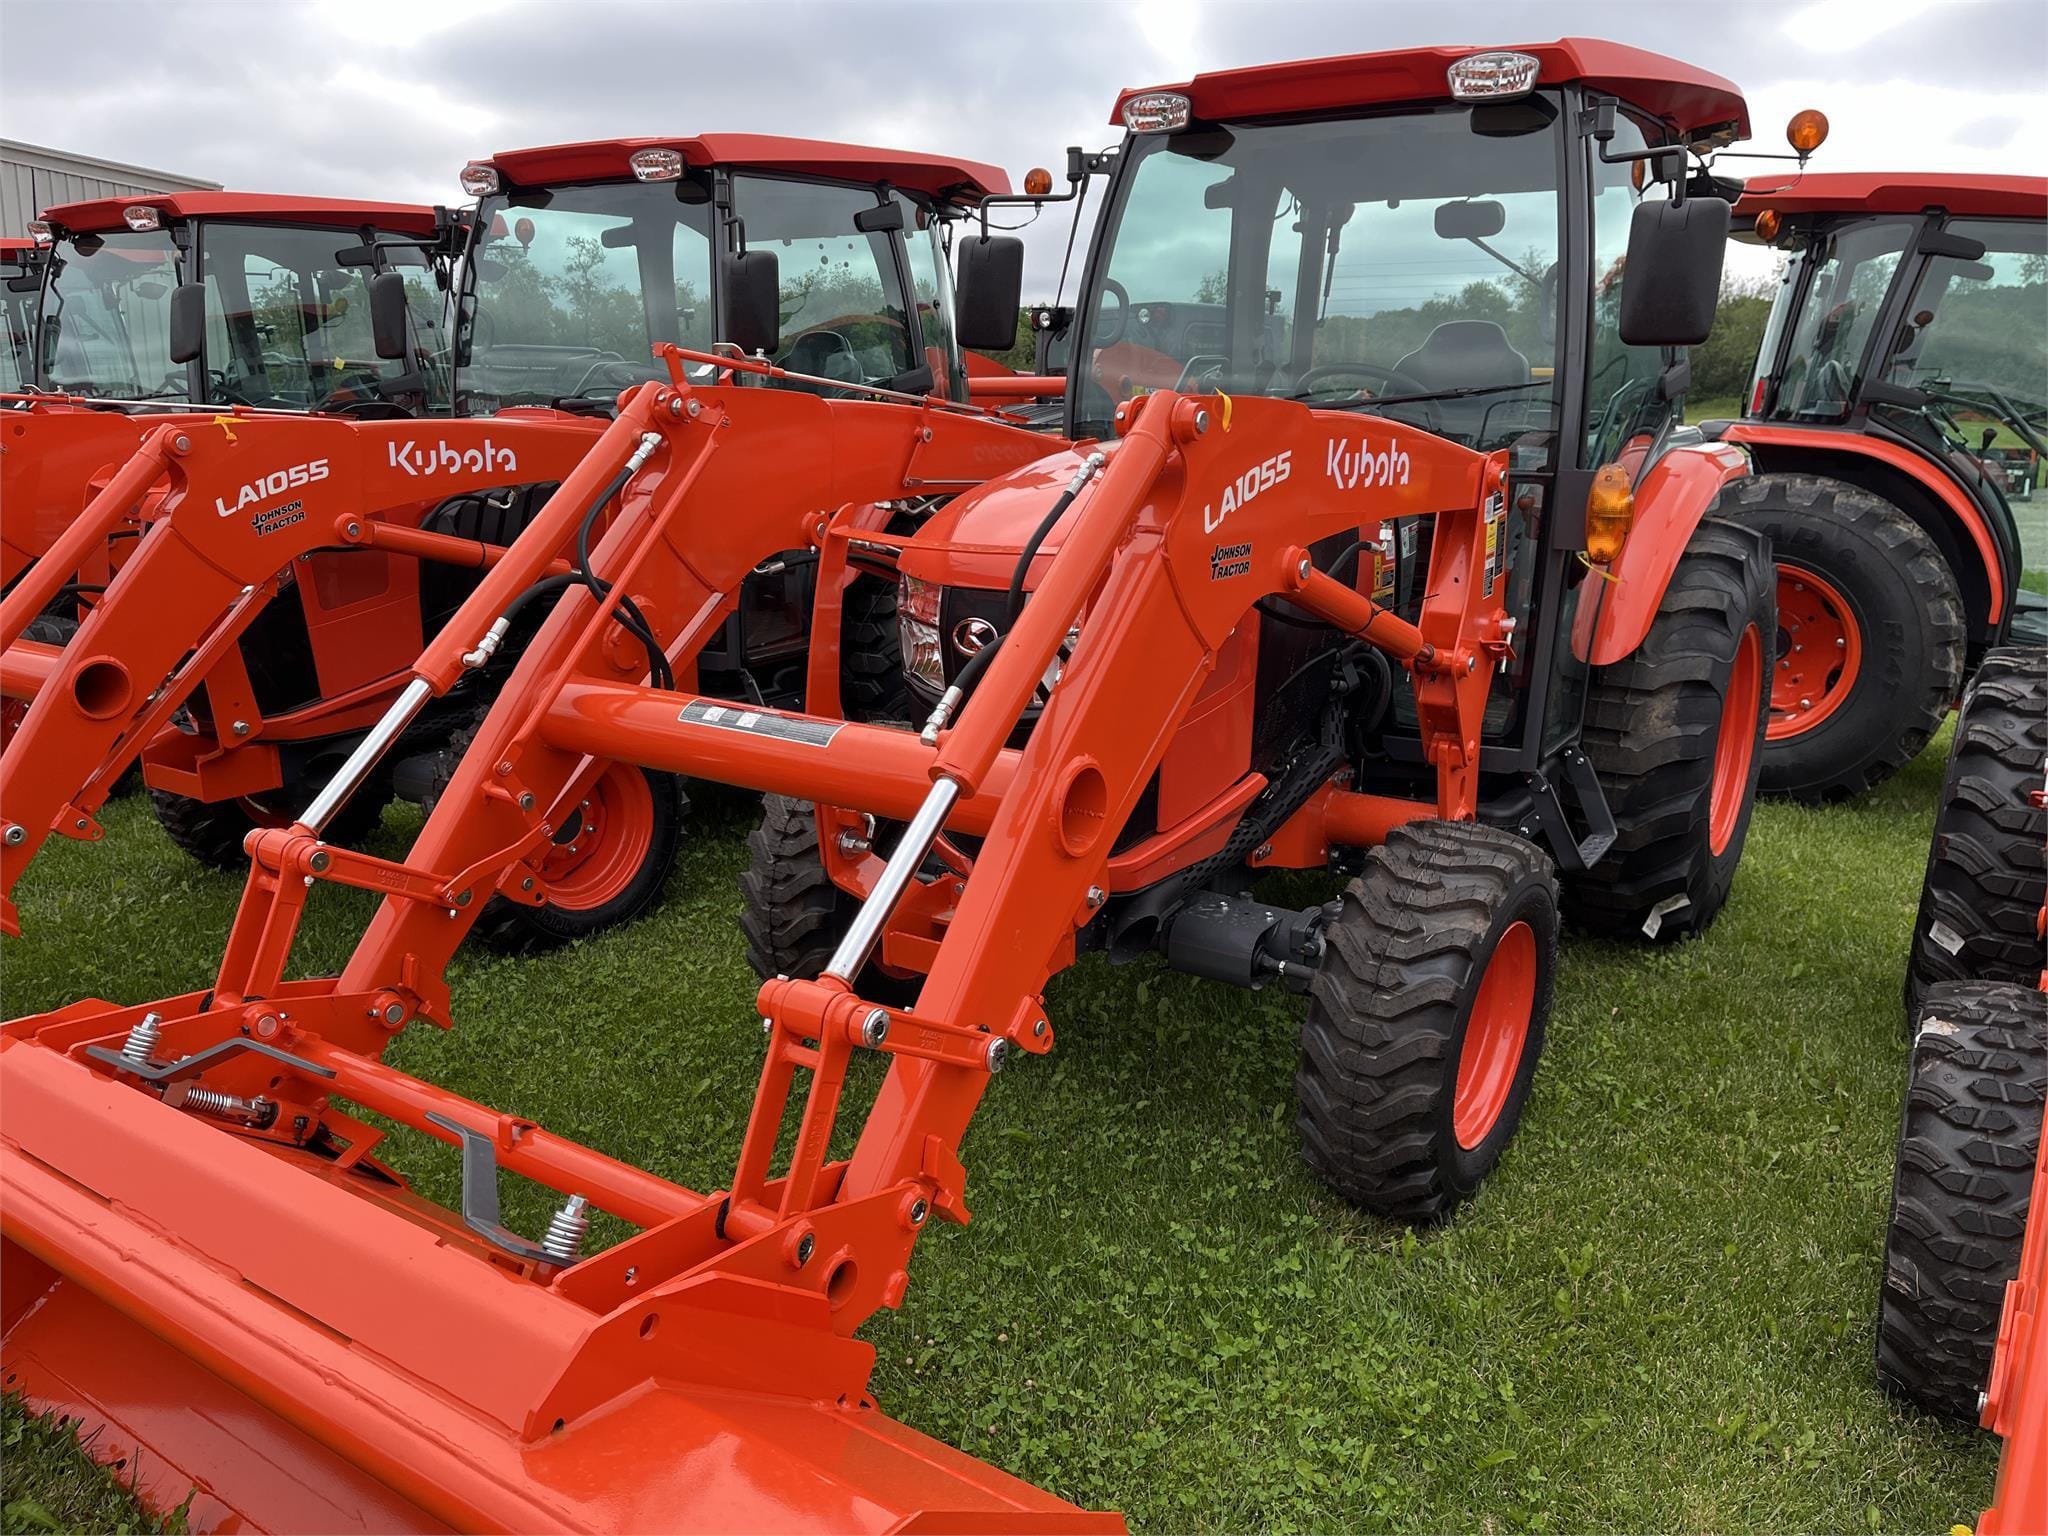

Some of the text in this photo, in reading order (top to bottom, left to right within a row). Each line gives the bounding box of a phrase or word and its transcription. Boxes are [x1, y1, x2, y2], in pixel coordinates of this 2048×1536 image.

[388, 439, 517, 476] Kubota
[1326, 438, 1410, 490] Kubota
[215, 458, 330, 518] LA1055
[1204, 450, 1292, 534] LA1055
[252, 500, 303, 527] JOHNSON
[255, 512, 306, 537] TRACTOR
[1210, 543, 1252, 563] JOHNSON
[1211, 561, 1250, 580] TRACTOR
